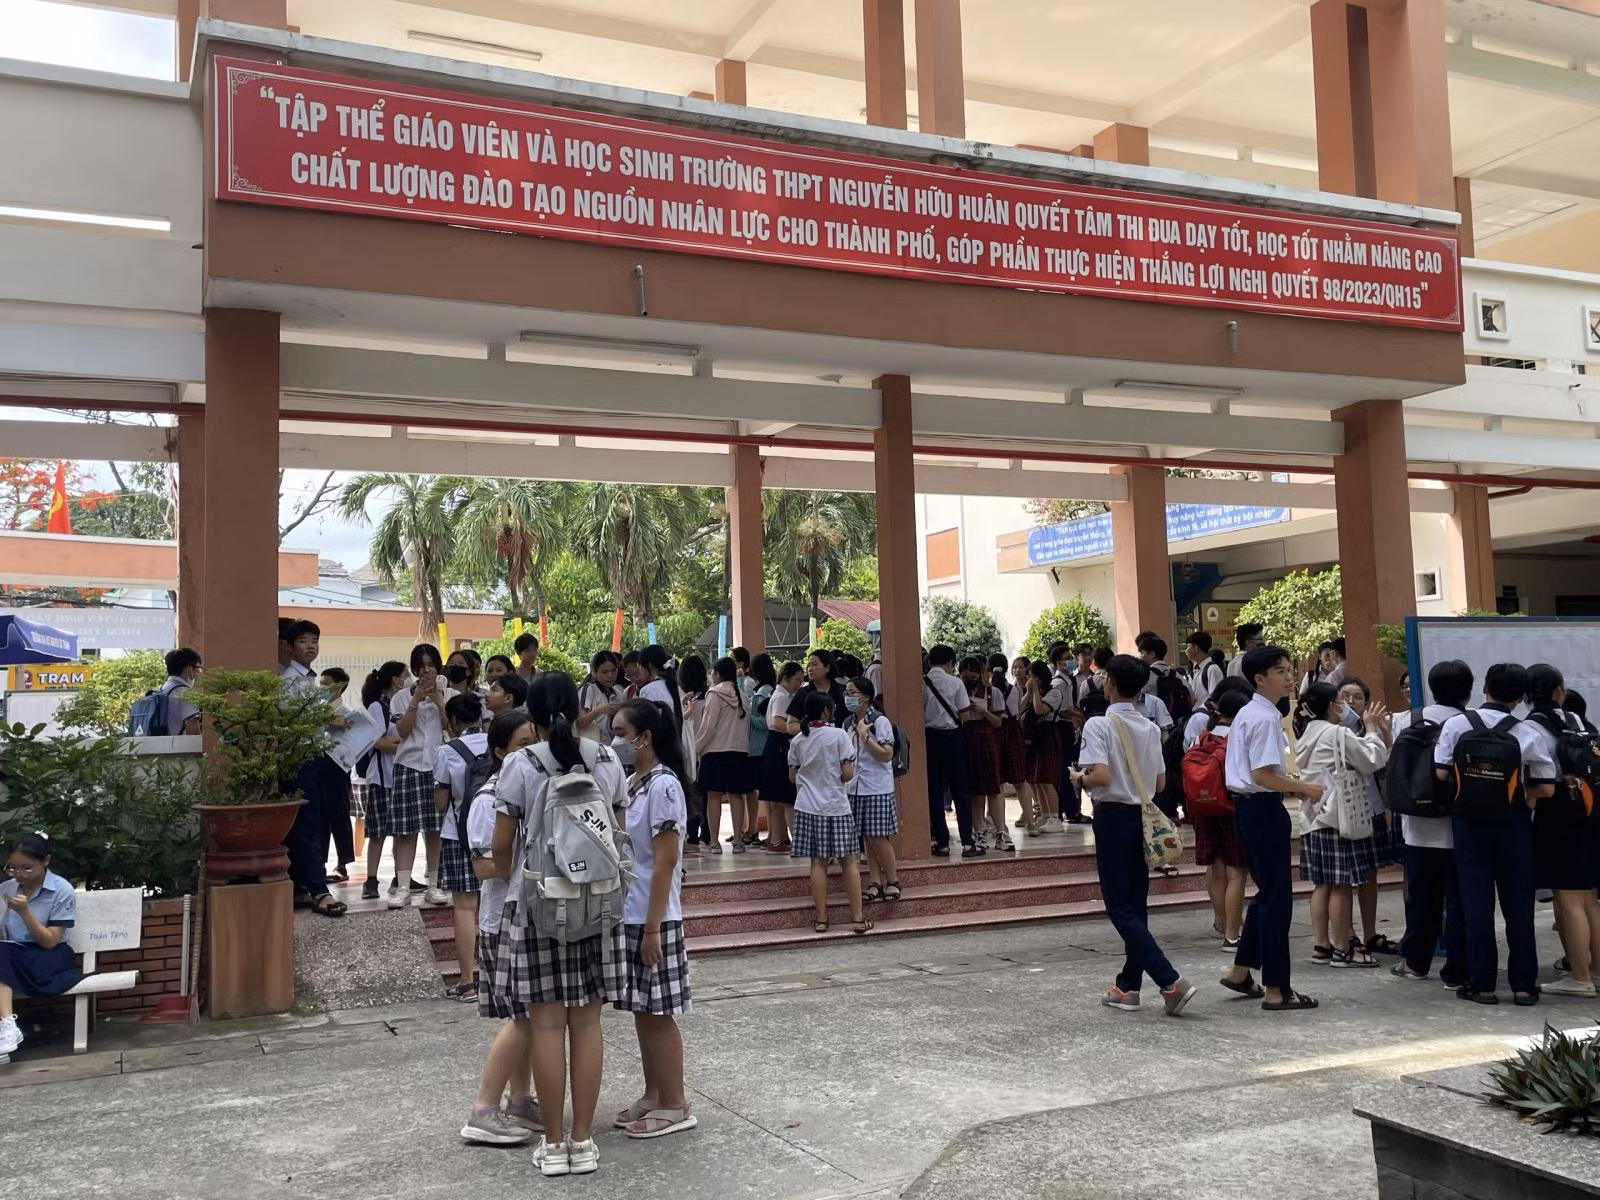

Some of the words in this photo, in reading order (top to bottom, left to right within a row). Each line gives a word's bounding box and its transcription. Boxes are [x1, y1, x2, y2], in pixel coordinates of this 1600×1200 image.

[290, 146, 361, 191] CHẤT
[369, 161, 455, 206] LƯỢNG
[462, 170, 513, 209] ĐÀO
[520, 181, 566, 220] TẠO
[573, 186, 655, 227] NGUỒN
[661, 199, 724, 236] NHÂN
[730, 208, 770, 245] LỰC
[777, 215, 818, 247] CHO
[824, 218, 890, 255] THÀNH
[896, 224, 941, 264] PHỐ,
[946, 232, 984, 266] GÓP
[990, 235, 1040, 273] PHẦN
[1045, 247, 1090, 281] THỰC
[1095, 250, 1136, 286] HIỆN
[1139, 250, 1195, 287] THẮNG
[1199, 264, 1225, 291] LỢI
[1229, 269, 1268, 300] NGHỊ
[1271, 269, 1318, 300] QUYẾT
[336, 98, 385, 142] THỂ
[394, 111, 454, 152] GIÁO
[461, 120, 519, 161] VIÊN
[526, 128, 557, 165] VÀ
[564, 137, 612, 177] HỌC
[619, 147, 674, 182] SINH
[680, 155, 767, 196] TRƯỜNG
[772, 169, 823, 202] THPT
[829, 174, 909, 213] NGUYỄN
[914, 186, 954, 219] HỮU
[958, 193, 1009, 226] HUÂN
[1014, 199, 1071, 233] QUYẾT
[1075, 206, 1112, 238] TÂM
[1116, 214, 1143, 241] THI
[1148, 217, 1181, 245] ĐUA
[1185, 222, 1217, 254] DẠY
[1221, 220, 1253, 257] TỐT,
[1256, 231, 1288, 260] HỌC
[1292, 228, 1319, 261] TỐT
[1323, 232, 1367, 266] NHẰM
[1371, 241, 1411, 271] NÂNG
[1414, 250, 1442, 275] CAO
[38, 672, 84, 687] TRẠM
[579, 809, 607, 832] SJN
